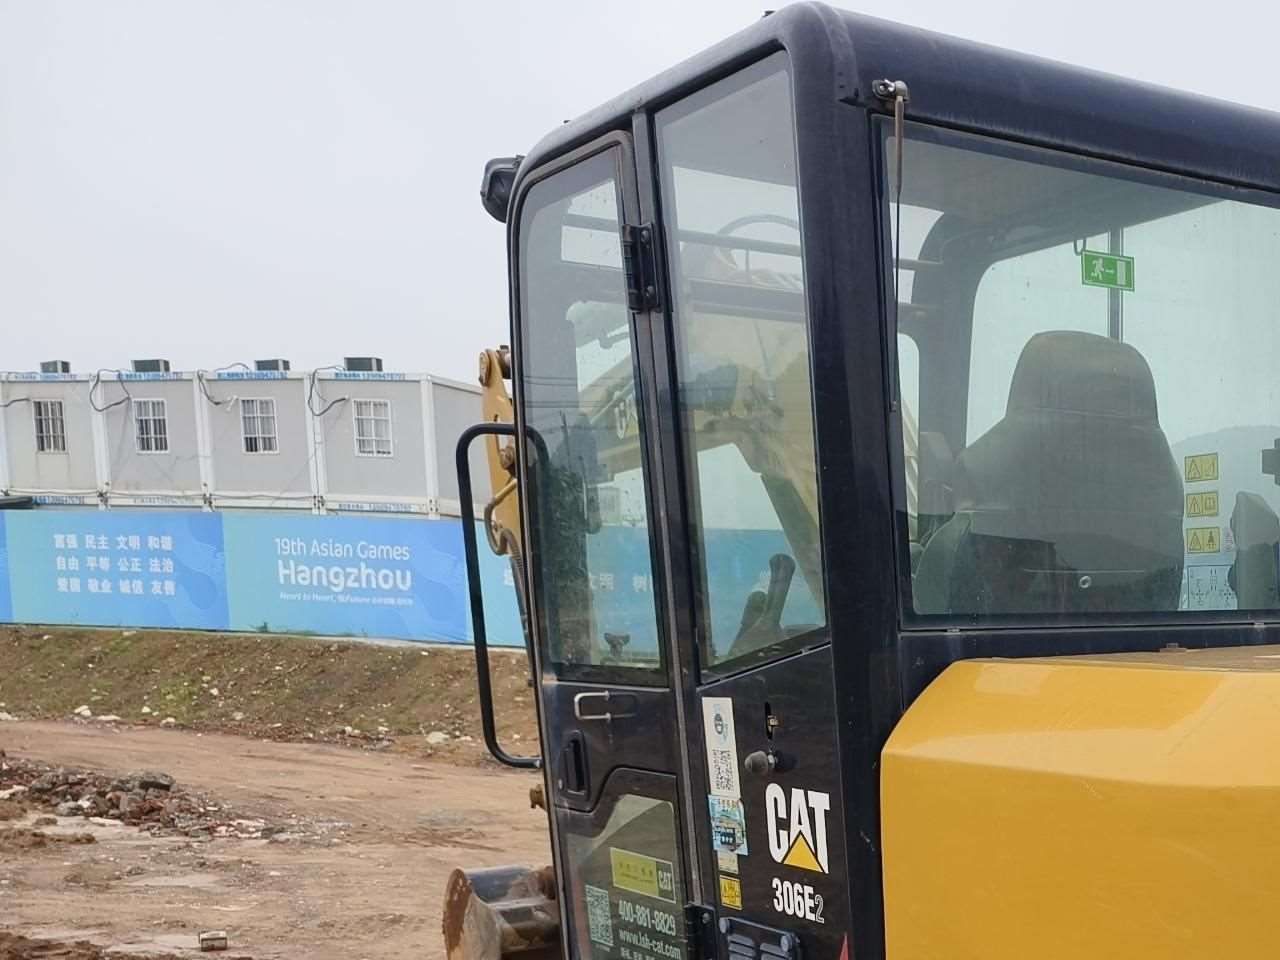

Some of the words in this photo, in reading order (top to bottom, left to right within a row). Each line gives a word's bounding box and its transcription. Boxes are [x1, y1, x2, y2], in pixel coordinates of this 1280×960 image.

[275, 537, 306, 556] 19th
[310, 538, 353, 558] Asian
[357, 541, 411, 560] Games
[277, 559, 412, 592] Hangzhou
[765, 782, 830, 874] CAT
[658, 869, 672, 891] CAT
[772, 877, 825, 924] 306E2
